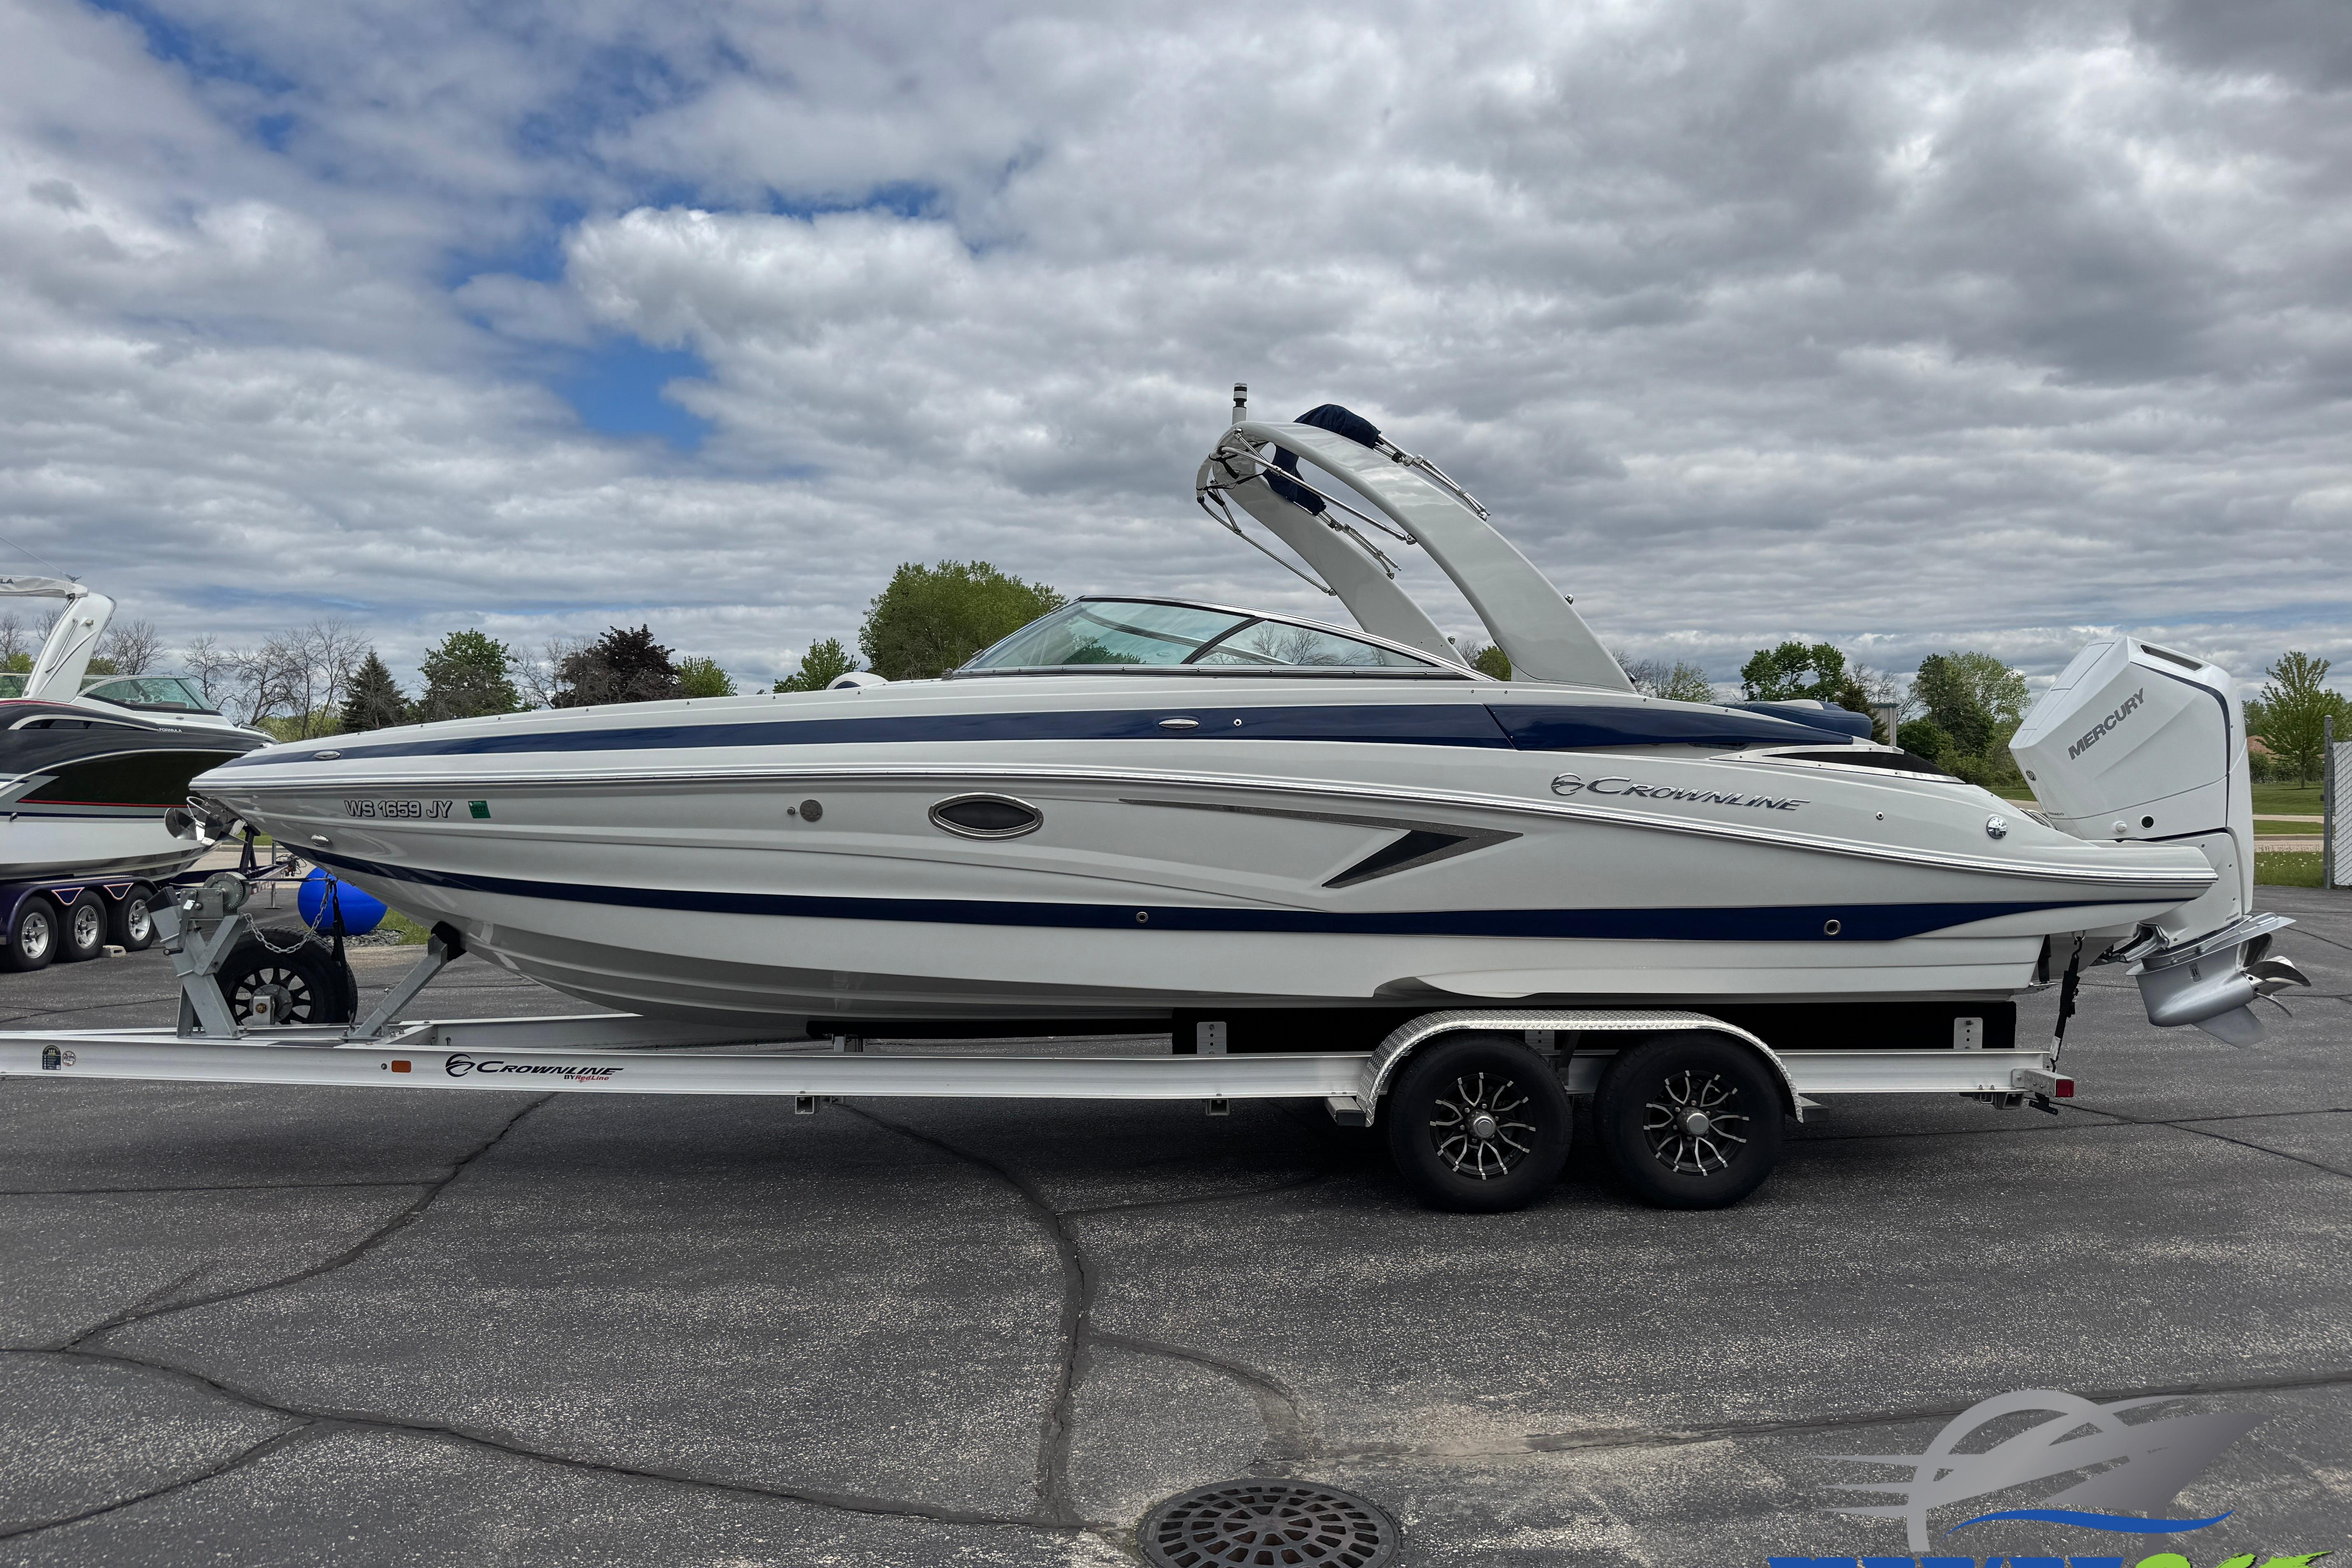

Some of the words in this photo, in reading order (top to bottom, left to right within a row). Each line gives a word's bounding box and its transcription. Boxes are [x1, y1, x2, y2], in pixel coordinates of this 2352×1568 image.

[2068, 687, 2144, 760] MERCURY
[344, 800, 375, 817] WS
[378, 800, 421, 818] 1659
[426, 800, 453, 818] JY
